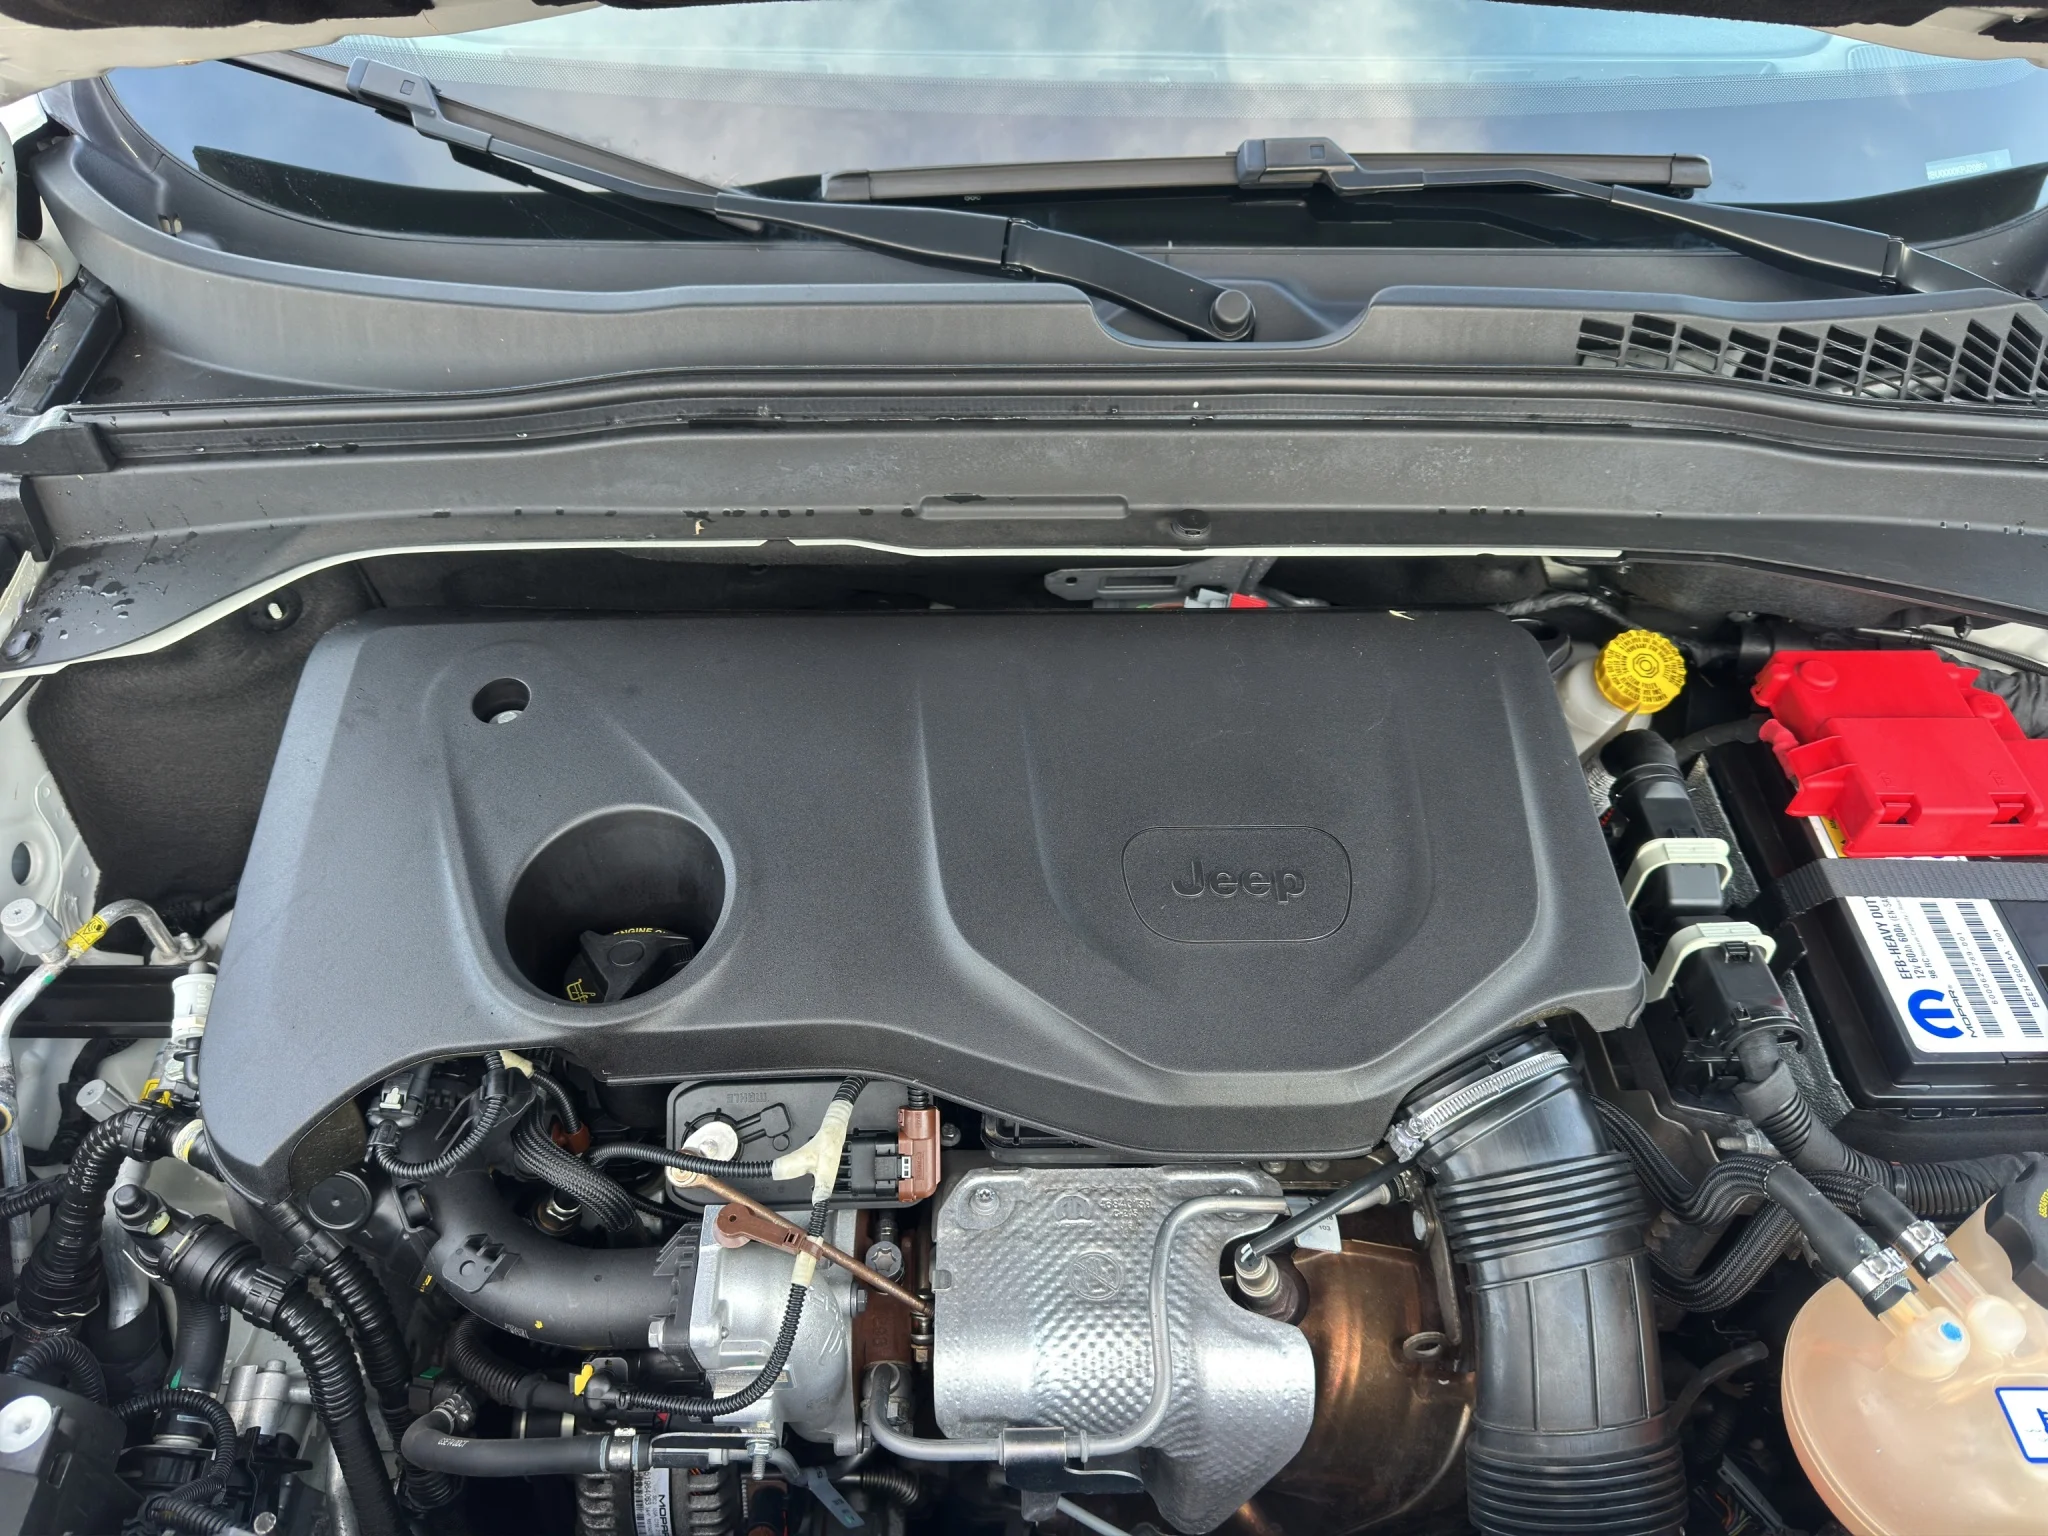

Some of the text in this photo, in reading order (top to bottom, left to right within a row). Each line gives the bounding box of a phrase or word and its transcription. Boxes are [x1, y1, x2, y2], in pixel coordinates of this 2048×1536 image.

[1171, 860, 1307, 905] Jeep
[1875, 921, 1914, 980] EFB-HEAVY
[1948, 988, 1978, 1038] MOPAR
